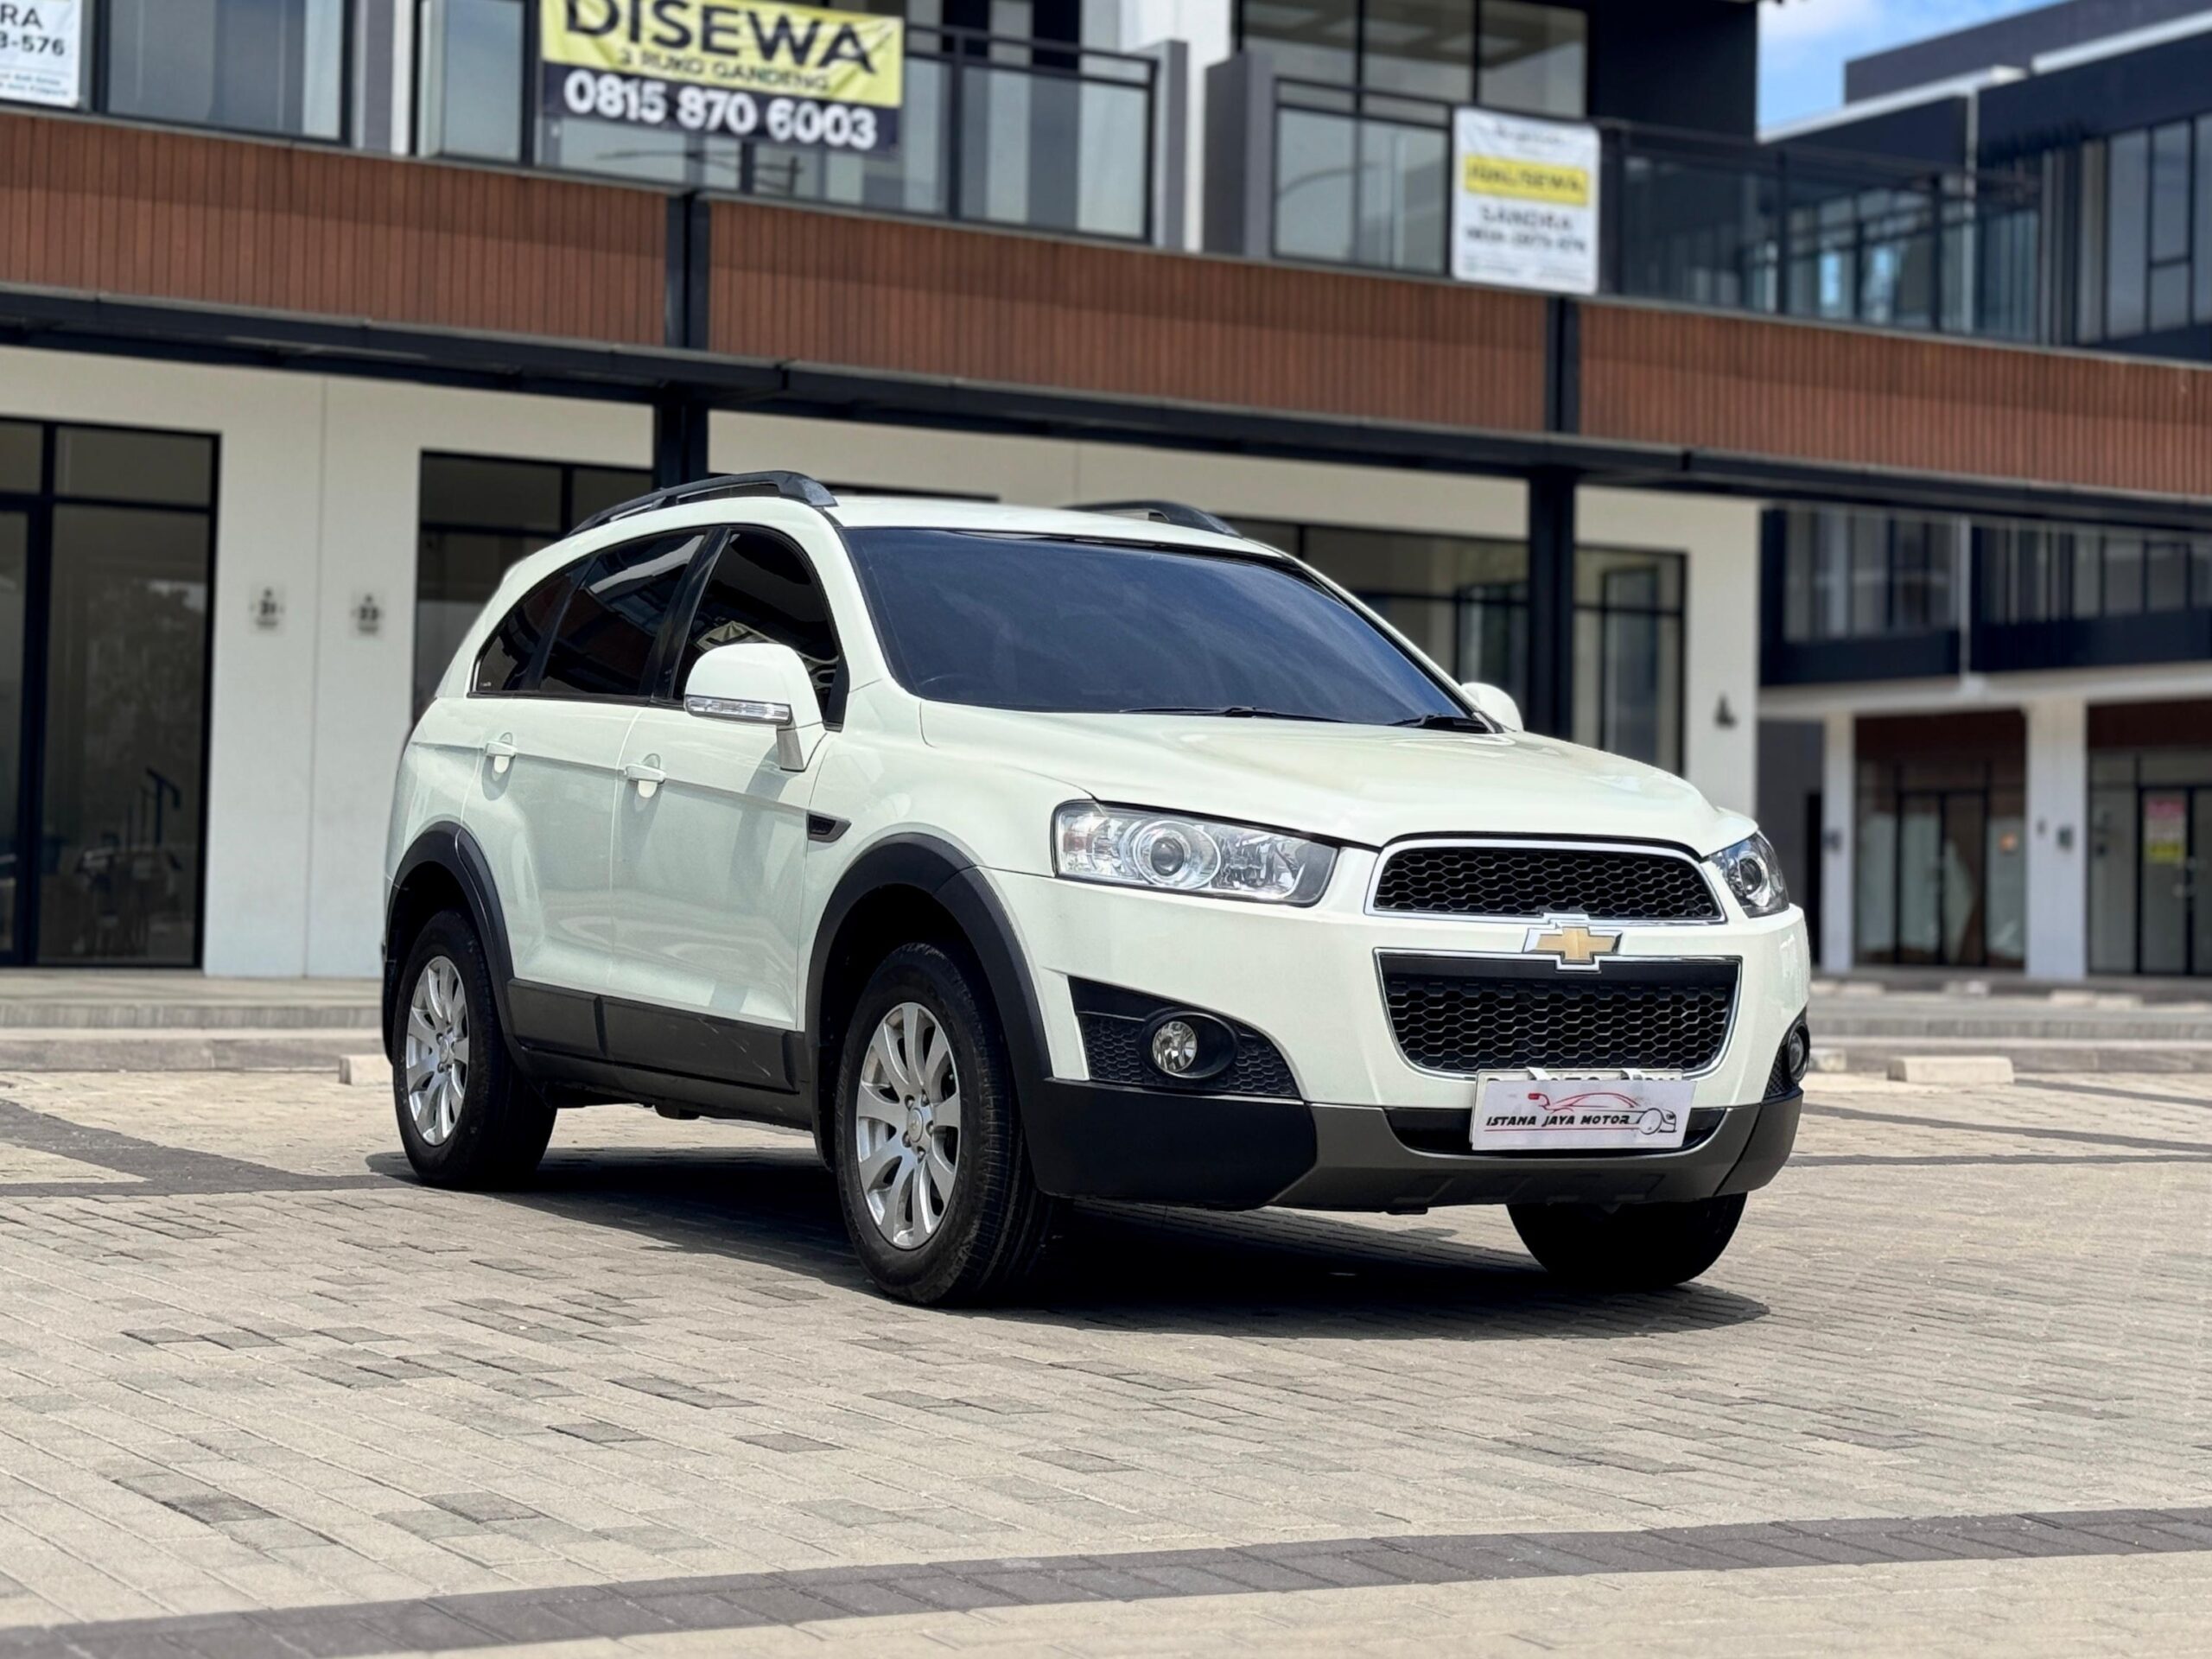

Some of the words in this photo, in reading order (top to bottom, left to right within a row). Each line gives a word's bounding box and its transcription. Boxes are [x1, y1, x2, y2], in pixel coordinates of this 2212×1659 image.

[565, 0, 878, 75] DISEWA
[563, 69, 668, 124] 0815
[677, 86, 758, 135] 870
[766, 97, 878, 151] 6003
[1485, 1116, 1536, 1127] ISTANA
[1541, 1115, 1575, 1128] JAYA
[1580, 1114, 1630, 1125] MOTOR
